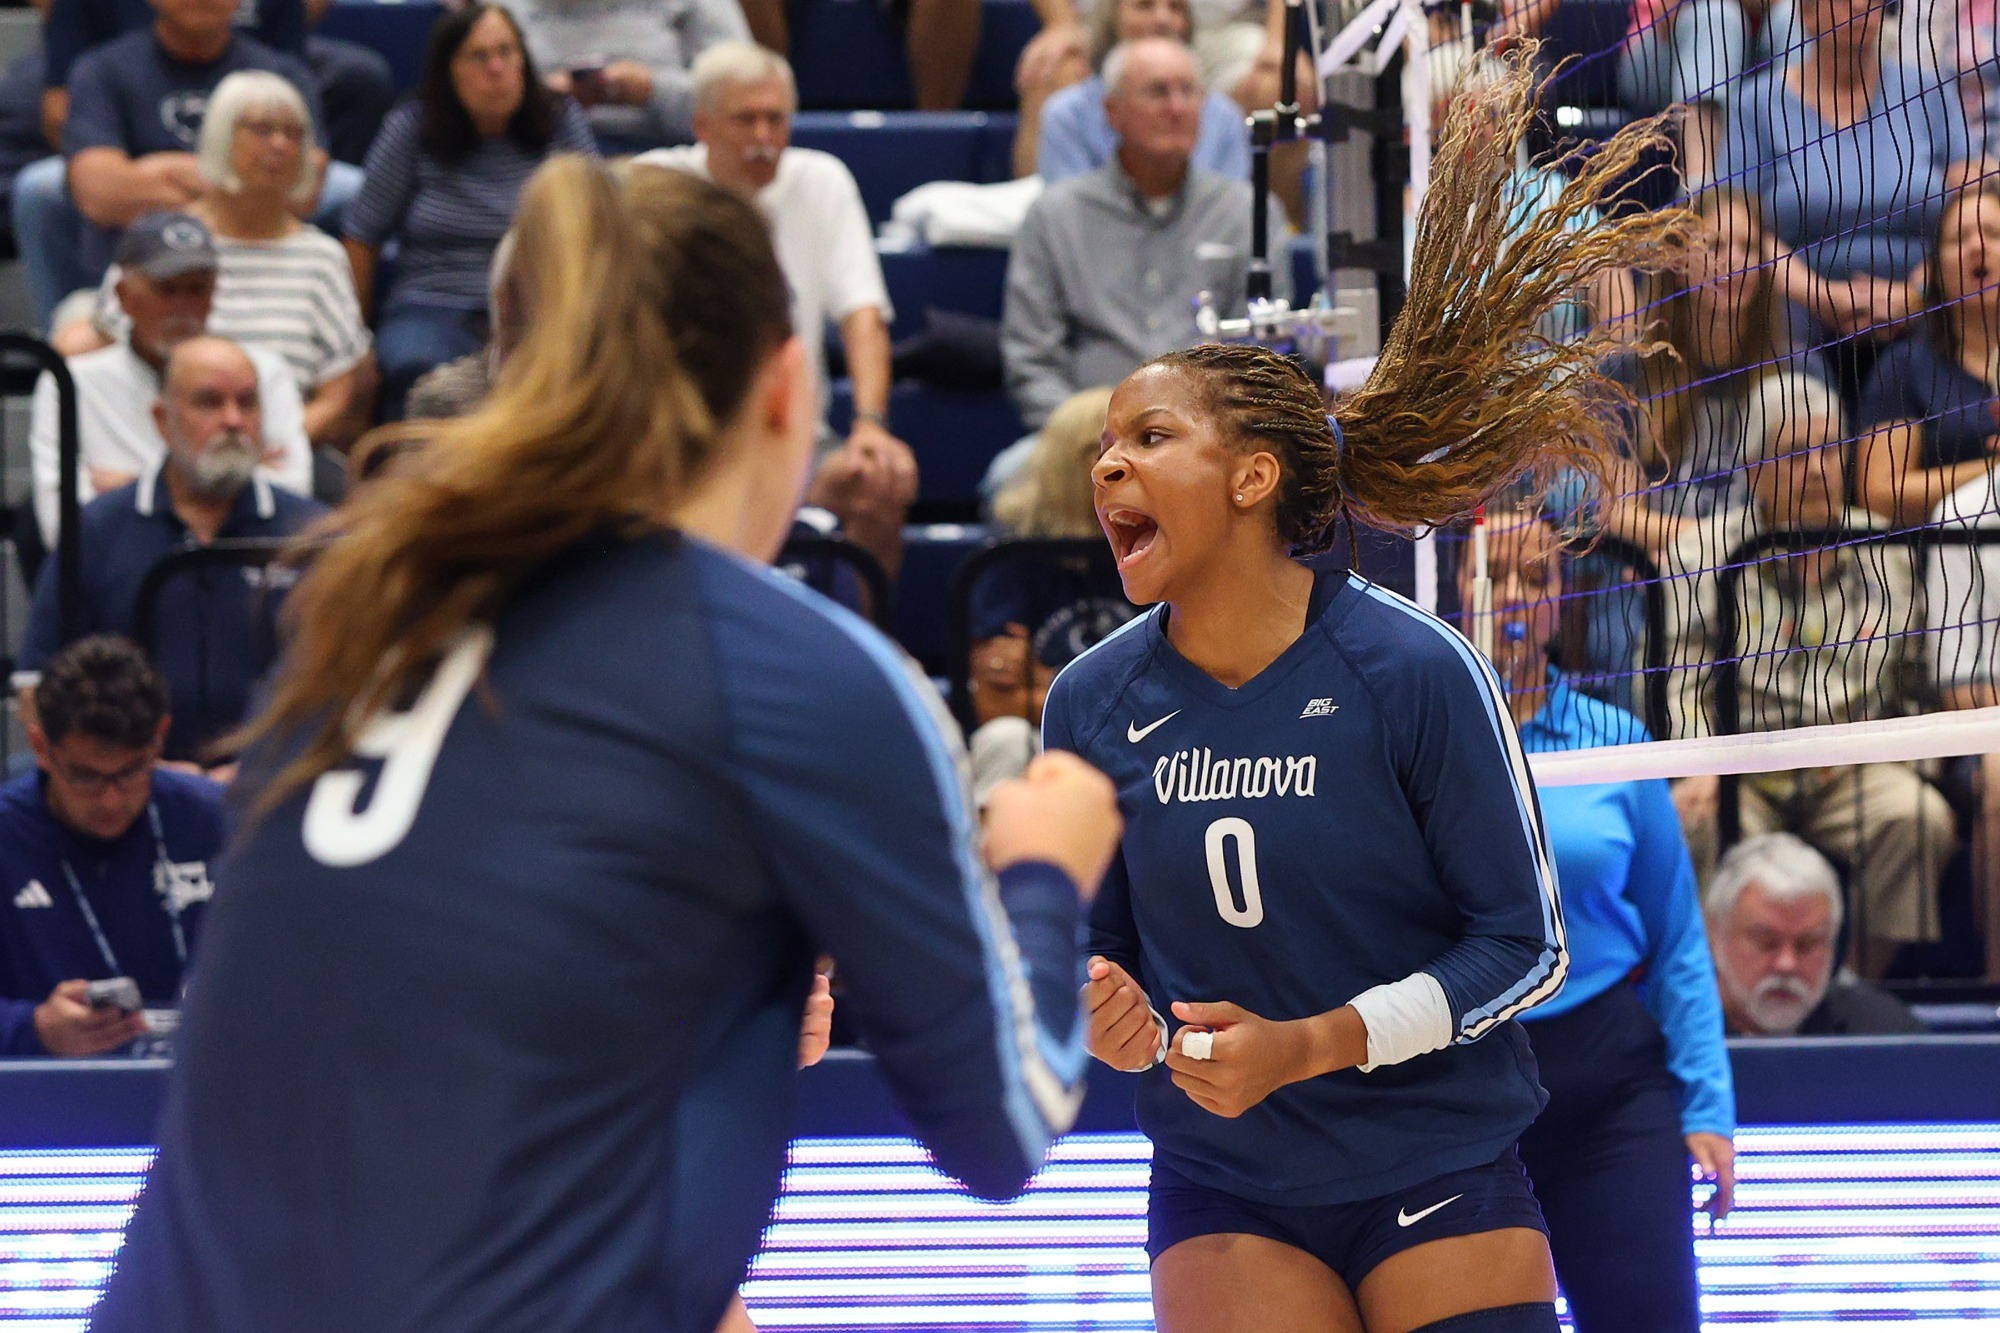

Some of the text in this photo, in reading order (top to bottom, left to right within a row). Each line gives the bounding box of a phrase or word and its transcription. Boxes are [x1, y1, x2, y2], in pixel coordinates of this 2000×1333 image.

[1302, 706, 1339, 714] EAST
[1307, 698, 1333, 706] BIG
[1152, 746, 1317, 804] Villanova
[1205, 816, 1264, 928] 0
